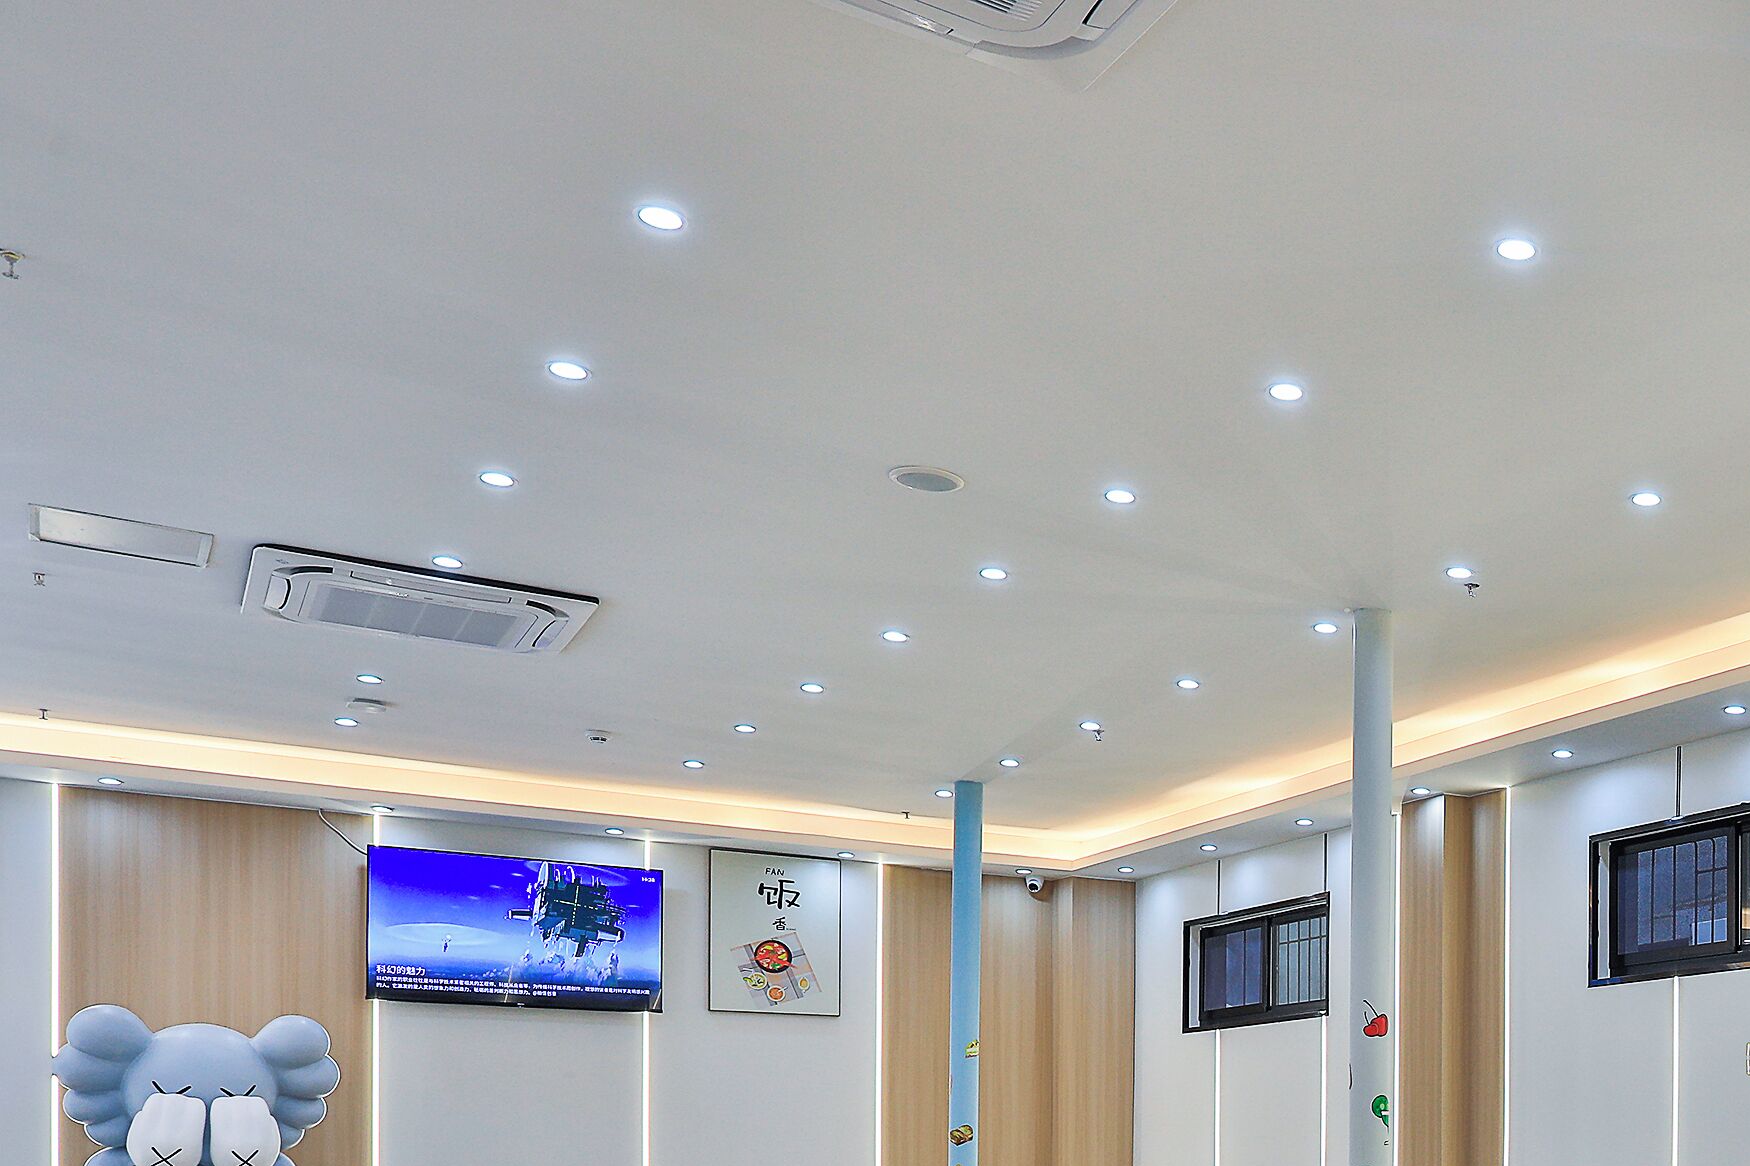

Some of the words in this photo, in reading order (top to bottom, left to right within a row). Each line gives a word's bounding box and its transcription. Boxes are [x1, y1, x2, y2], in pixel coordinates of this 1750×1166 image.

[765, 867, 785, 876] FAN
[758, 879, 801, 910] 饭
[772, 916, 787, 931] 香
[376, 964, 426, 976] 科幻的魅力
